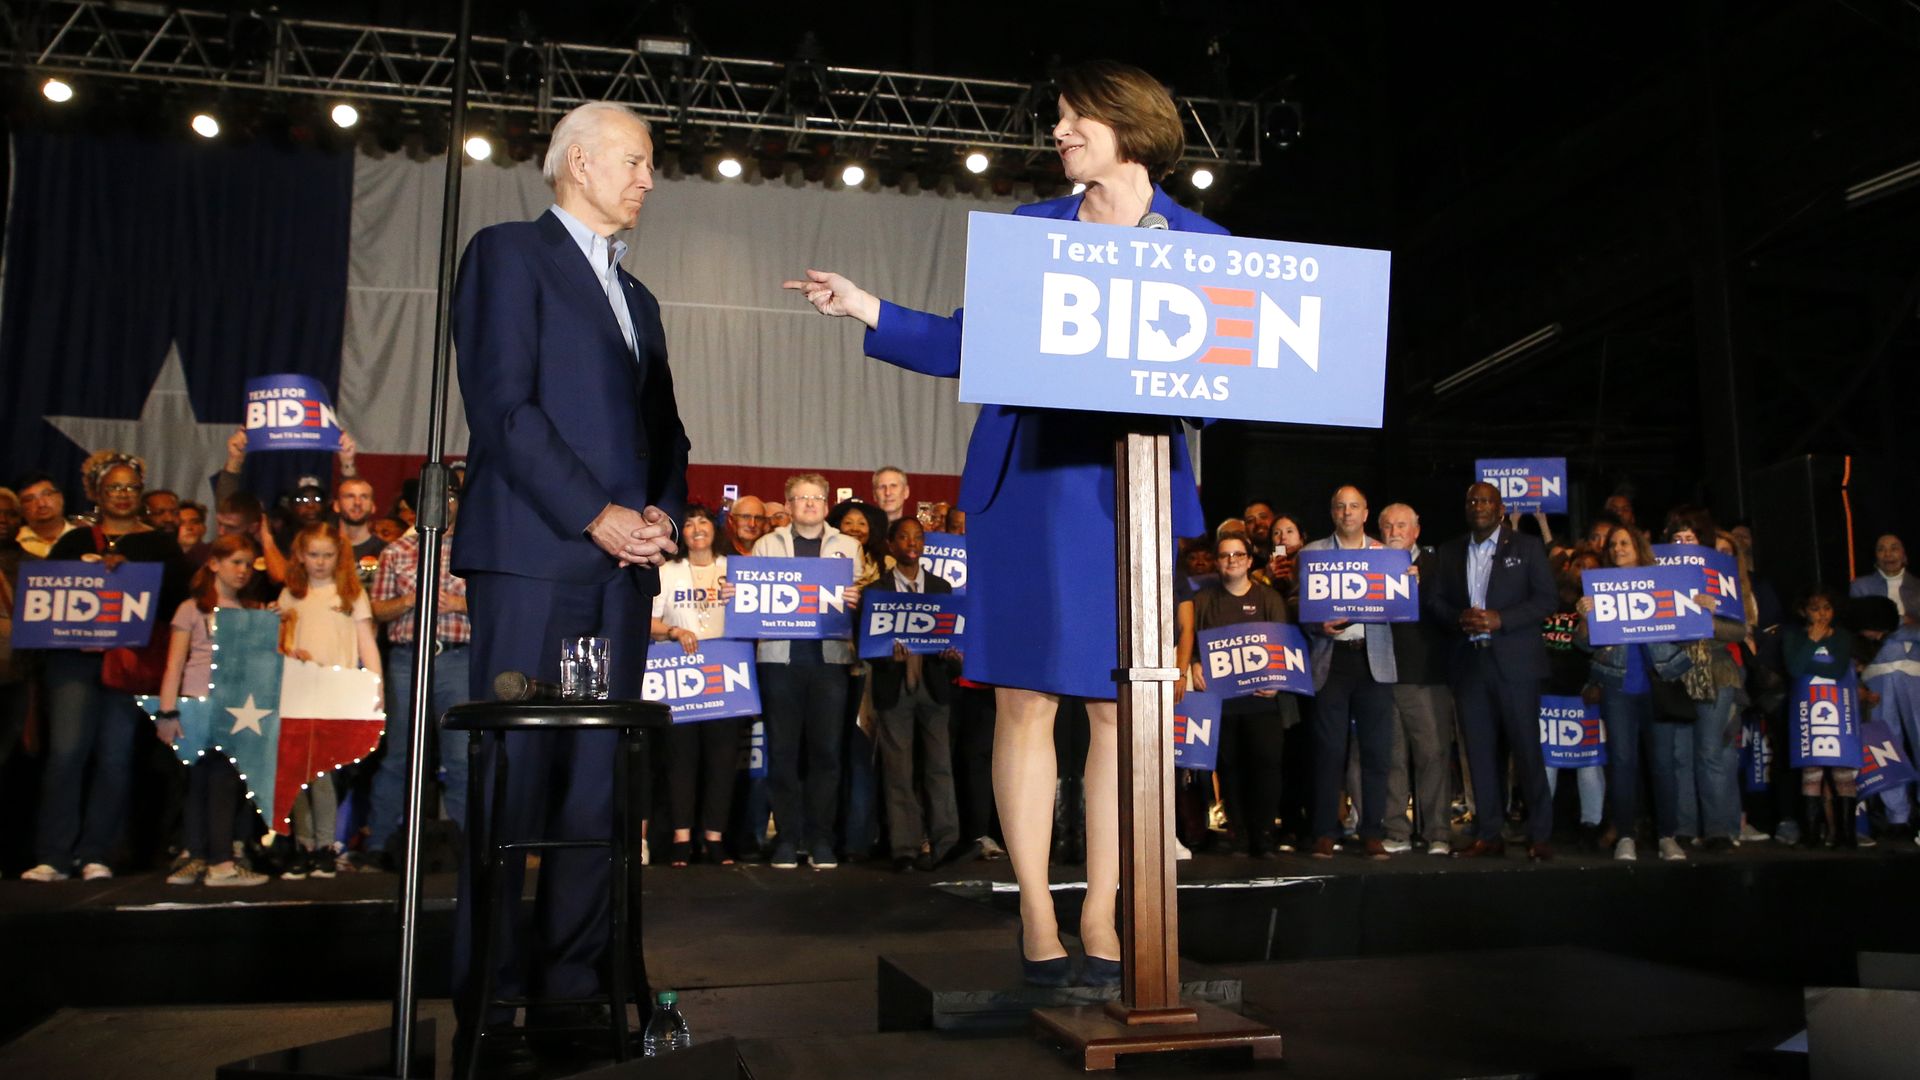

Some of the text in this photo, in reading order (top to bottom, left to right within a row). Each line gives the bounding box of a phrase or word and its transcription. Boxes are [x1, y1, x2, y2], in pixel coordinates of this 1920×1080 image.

[1048, 232, 1319, 283] Text TX to 30330
[1039, 271, 1322, 373] BIDEN
[1130, 369, 1230, 401] TEXAS
[249, 388, 306, 400] TEXAS FOR
[246, 399, 341, 430] BIDEN
[1483, 468, 1510, 476] TEXAS
[923, 545, 967, 559] EXAS FO
[1308, 562, 1369, 572] TEXAS FOR
[1655, 556, 1705, 566] XAS FOR
[28, 576, 105, 588] TEXAS FOR
[736, 570, 802, 582] TEXAS FOR
[1308, 573, 1410, 600] BIDEN
[1592, 580, 1655, 592] TEXAS FOR
[23, 589, 150, 622] BIDEN
[735, 583, 845, 614] BIDEN
[1594, 588, 1702, 622] BIDEN
[873, 603, 941, 612] TEXAS FOR
[1208, 634, 1267, 650] TEXAS FOR
[646, 654, 705, 669] EXAS FOR
[1209, 644, 1305, 679] BIDEN
[641, 662, 750, 701] BIDEN
[1541, 707, 1584, 718] XAS FOR
[1800, 701, 1810, 758] TEXAS FOR
